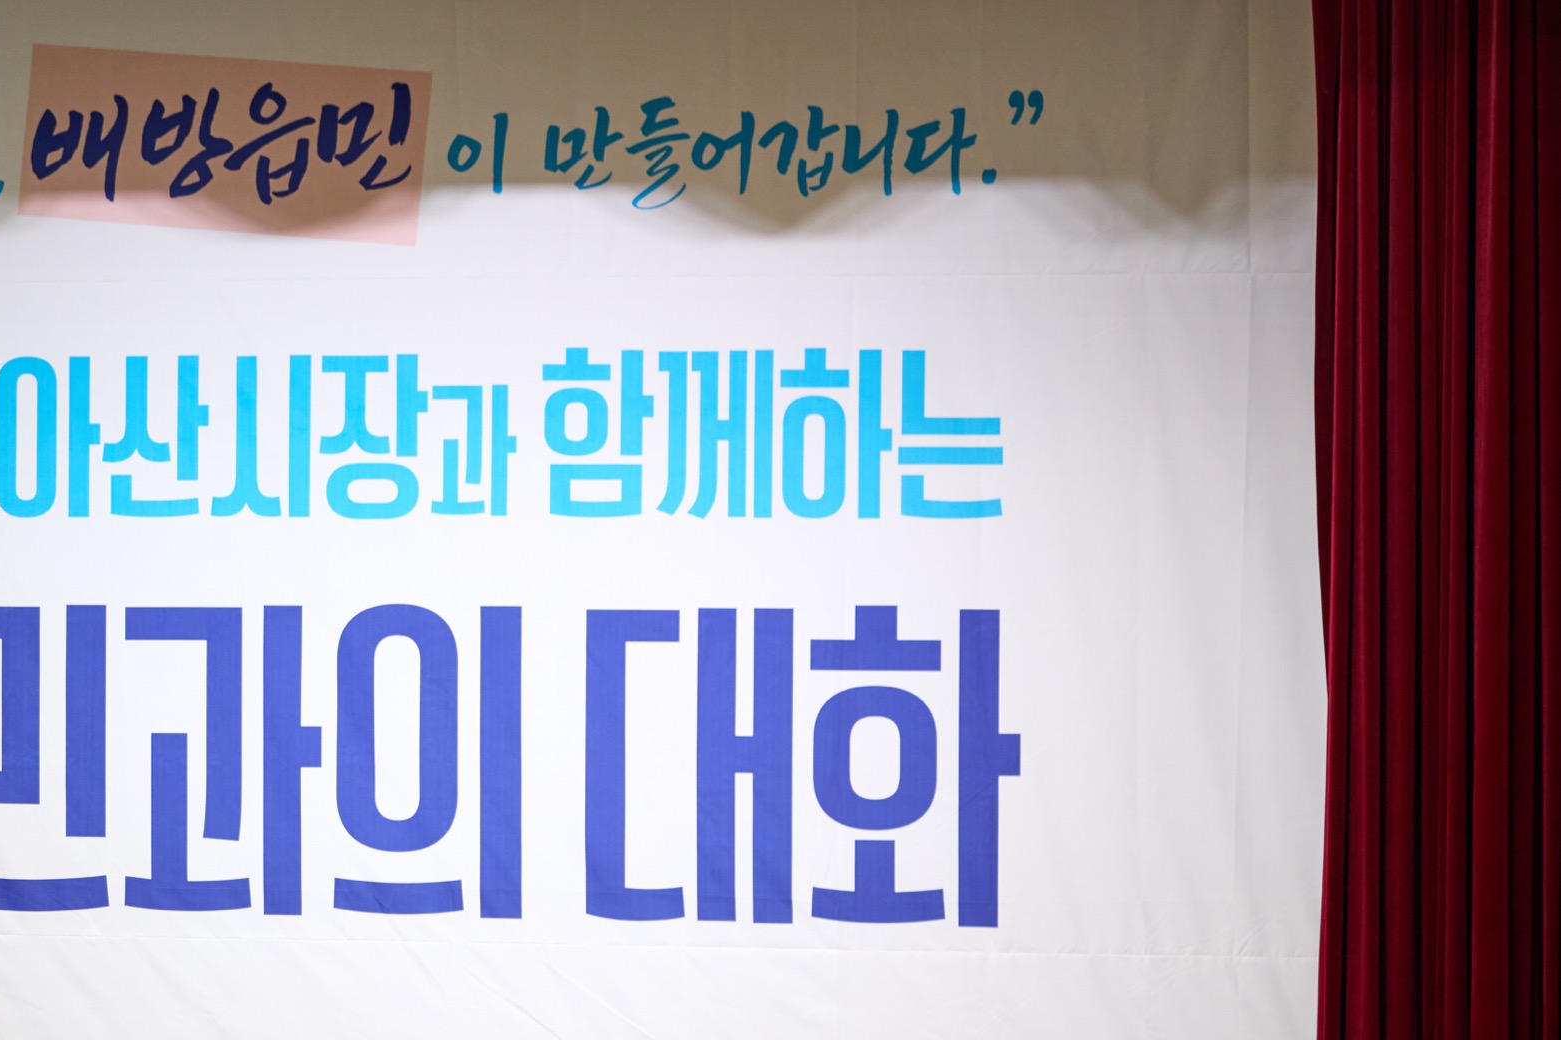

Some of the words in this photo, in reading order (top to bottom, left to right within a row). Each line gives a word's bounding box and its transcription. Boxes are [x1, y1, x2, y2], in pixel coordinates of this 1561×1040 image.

[29, 80, 413, 207] 배방읍민
[446, 112, 509, 195] 이
[542, 347, 1004, 519] 함께하는
[584, 605, 1022, 929] 대화
